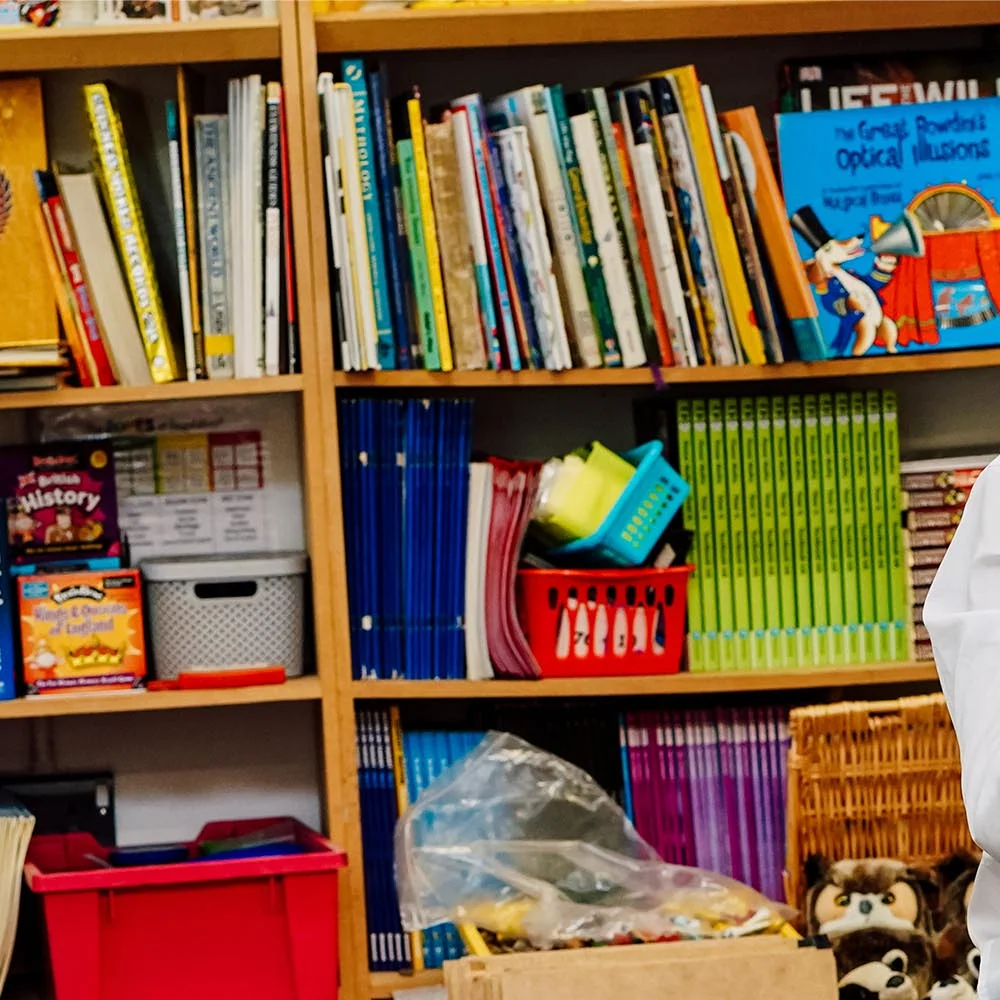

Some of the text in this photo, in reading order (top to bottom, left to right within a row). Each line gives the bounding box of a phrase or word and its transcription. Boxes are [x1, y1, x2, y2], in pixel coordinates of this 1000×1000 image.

[858, 117, 908, 141] Great
[836, 143, 904, 175] Optical
[20, 488, 101, 513] History
